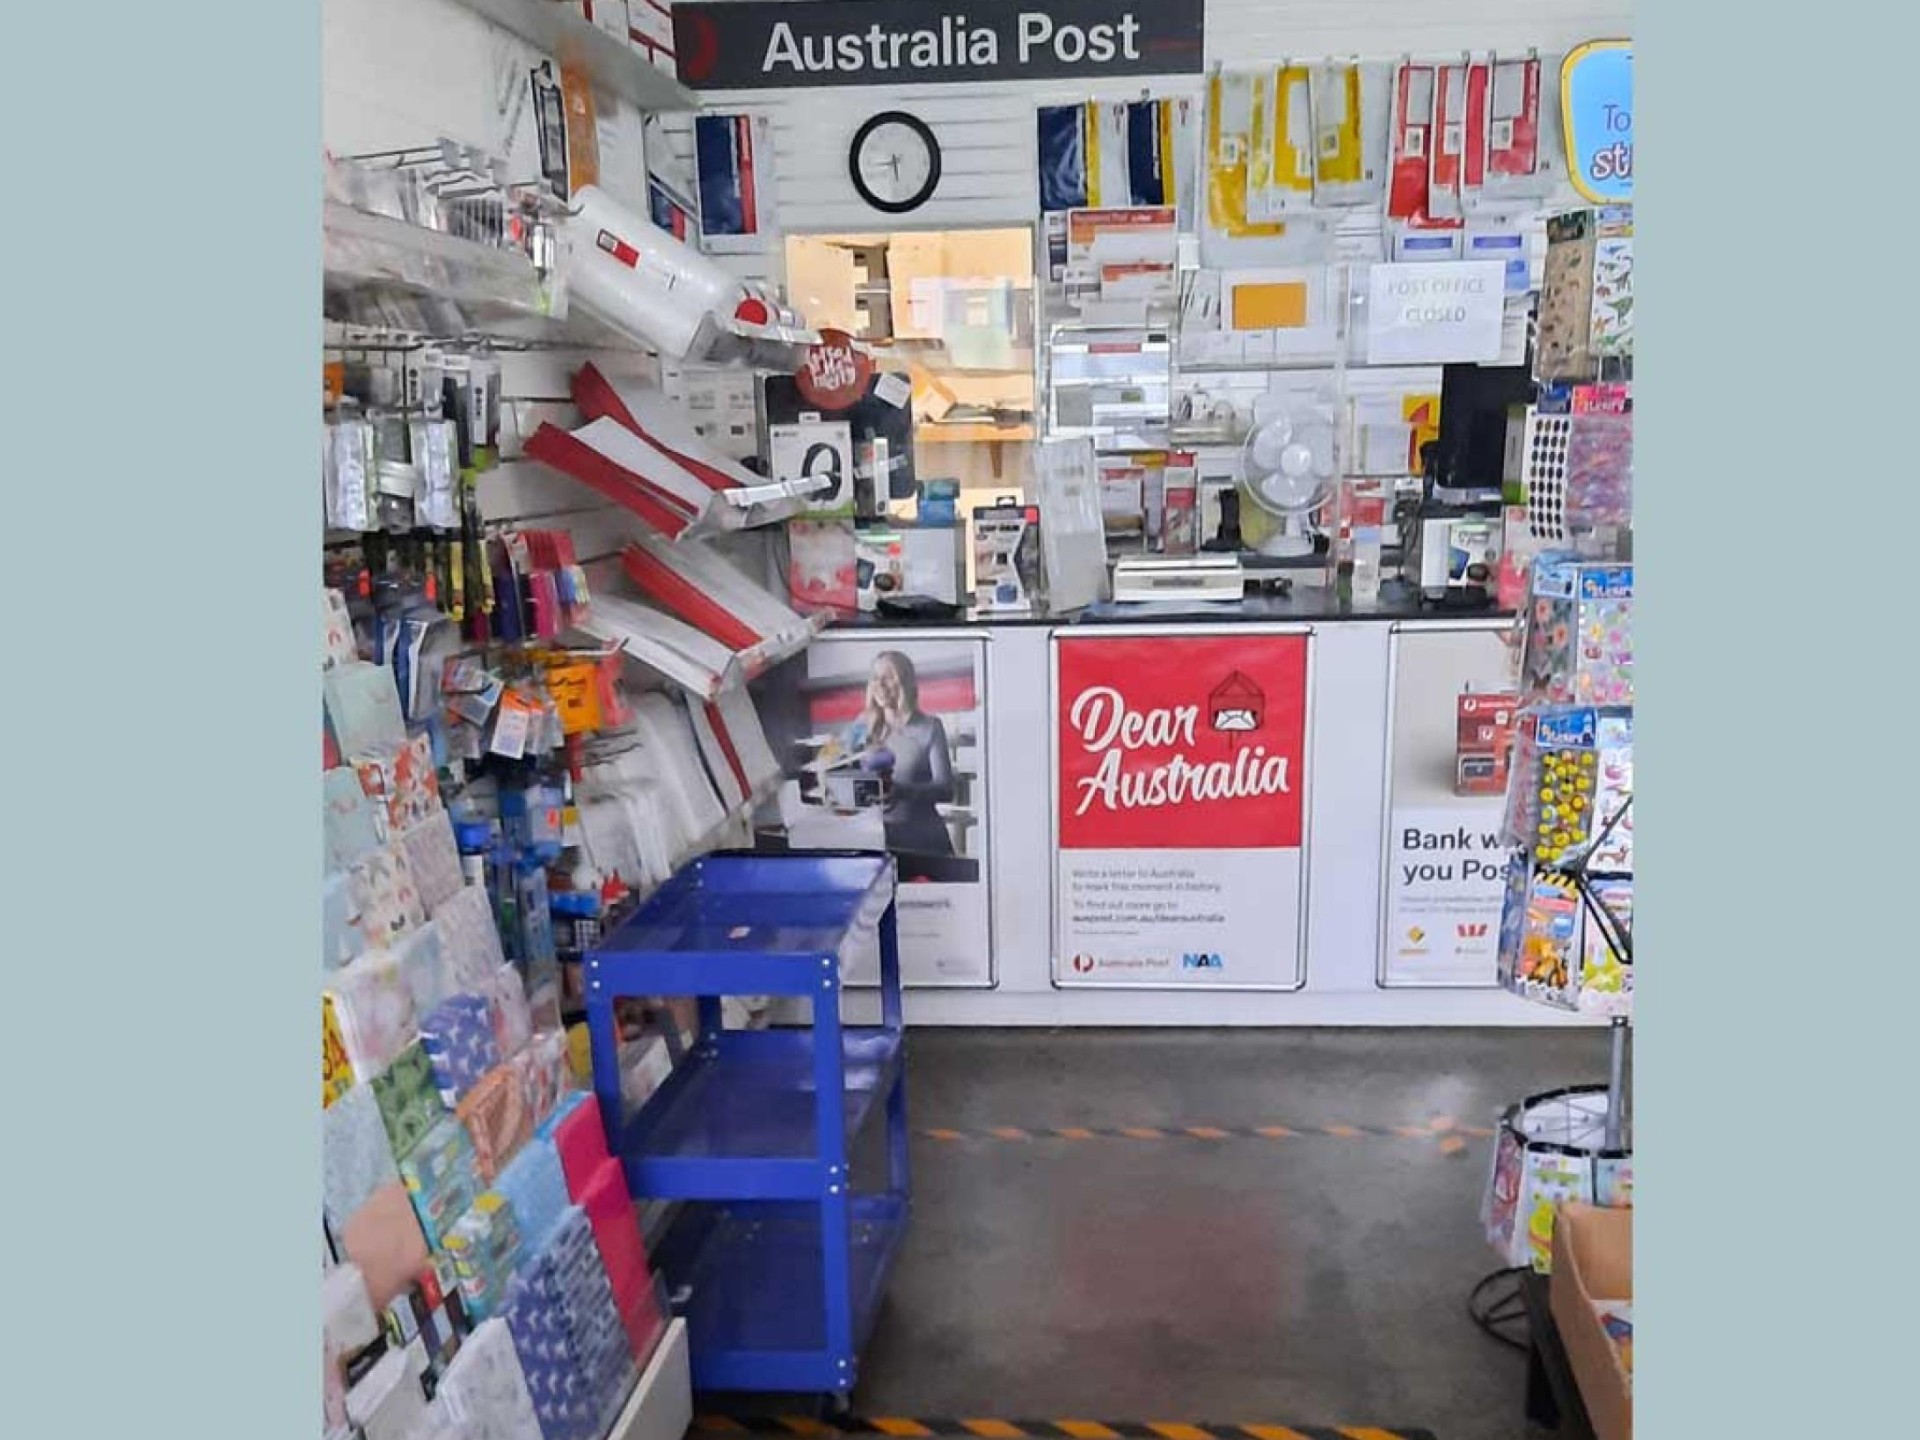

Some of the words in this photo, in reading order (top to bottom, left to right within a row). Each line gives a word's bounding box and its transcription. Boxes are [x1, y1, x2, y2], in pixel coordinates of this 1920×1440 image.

[761, 15, 998, 72] Australia
[1017, 12, 1140, 63] Post
[1590, 140, 1633, 182] st
[1387, 278, 1430, 295] POST
[1432, 277, 1486, 294] OFFICE
[1404, 304, 1467, 322] CLOSED
[1070, 685, 1199, 753] Dear
[1074, 745, 1291, 816] Australia
[1403, 826, 1473, 851] Bank
[1402, 863, 1453, 887] you
[1462, 858, 1512, 882] Pos
[1182, 953, 1224, 968] NAA
